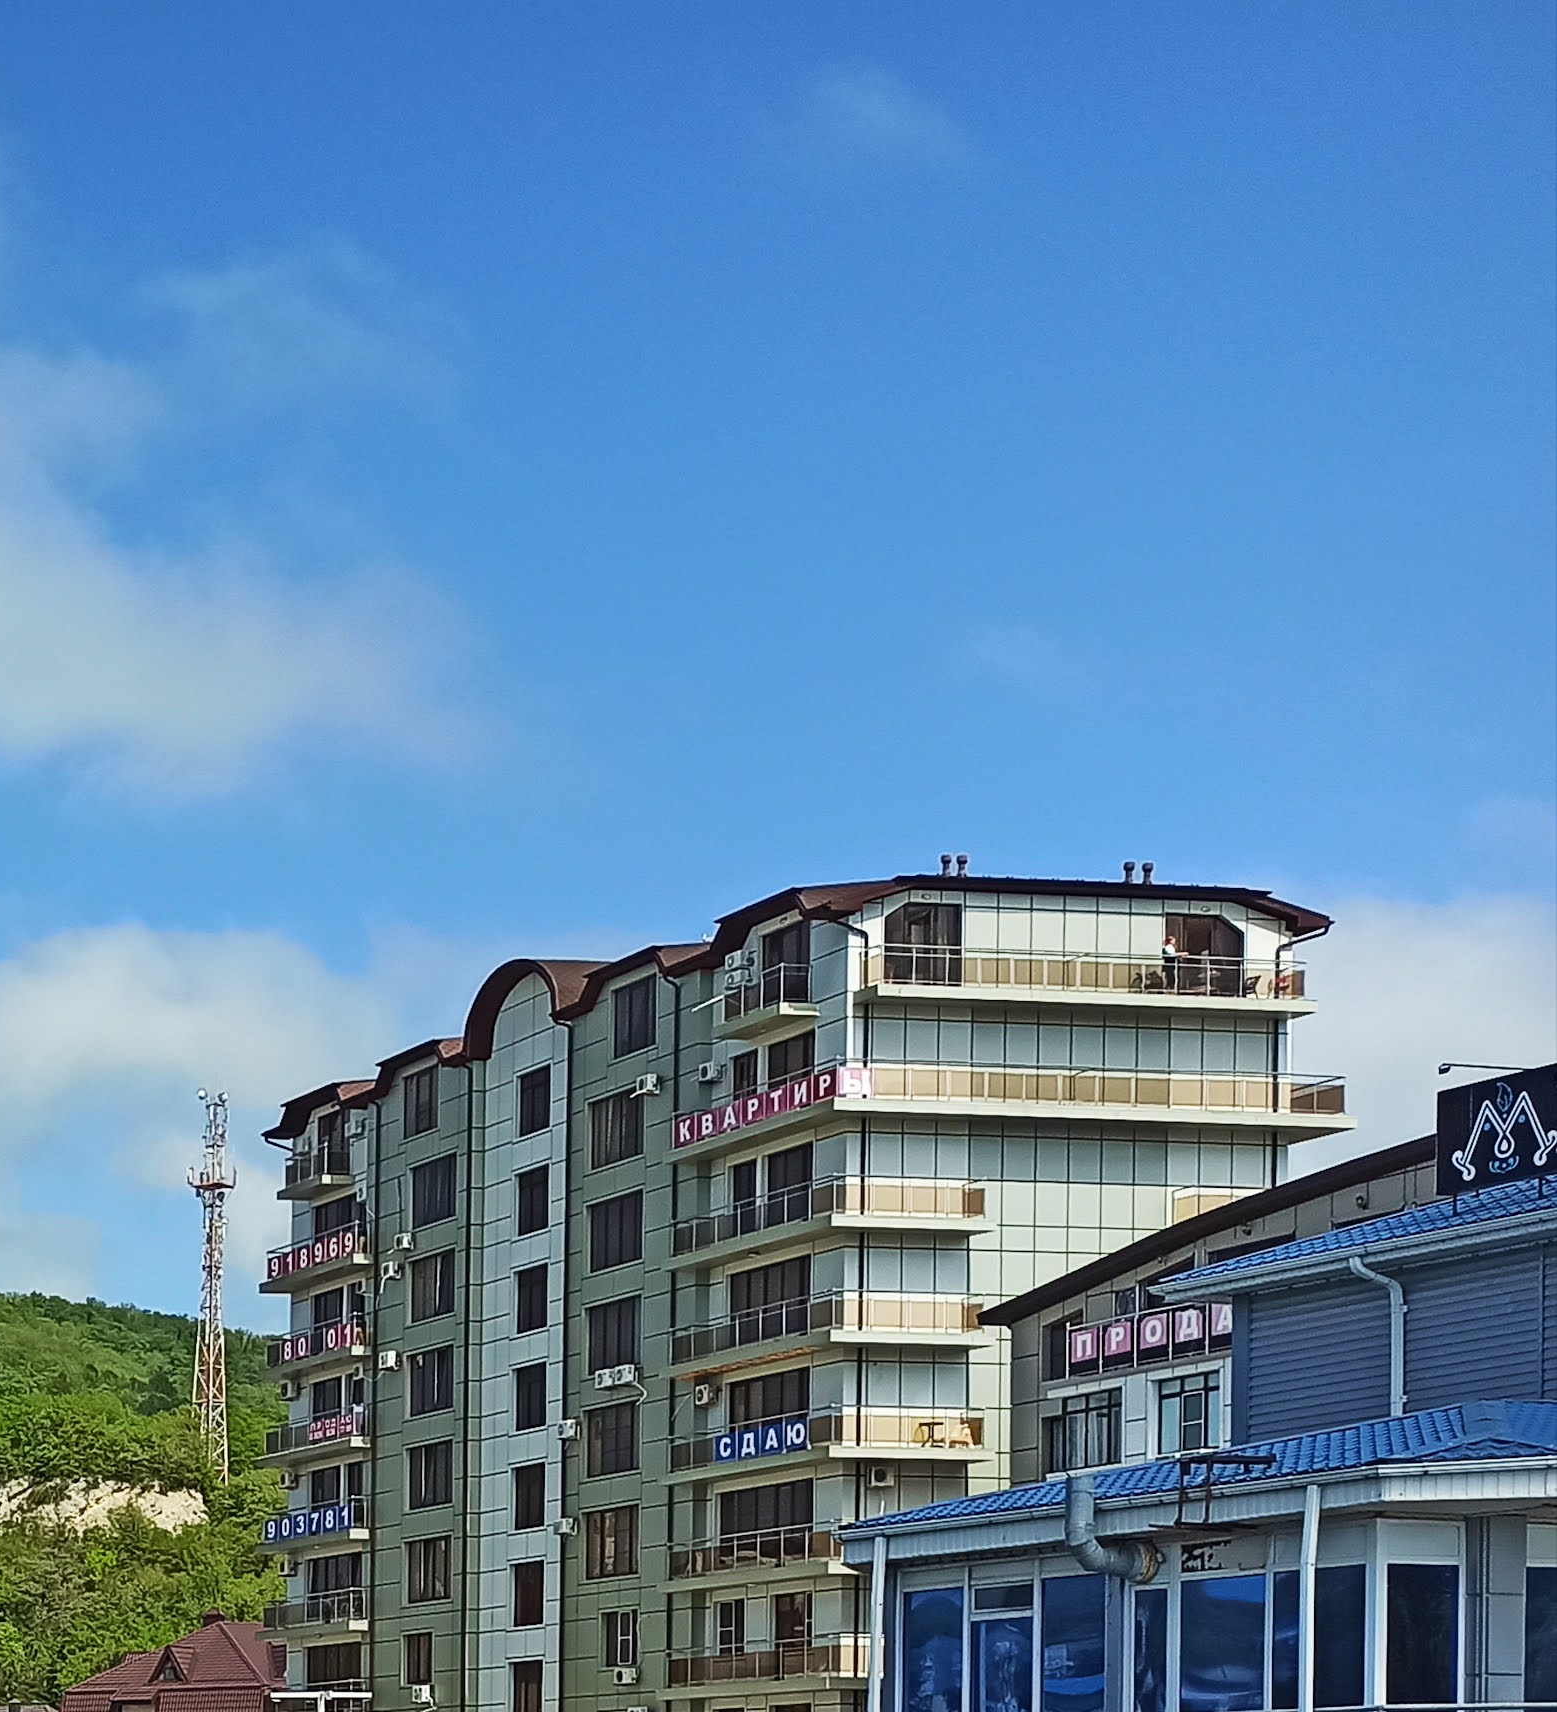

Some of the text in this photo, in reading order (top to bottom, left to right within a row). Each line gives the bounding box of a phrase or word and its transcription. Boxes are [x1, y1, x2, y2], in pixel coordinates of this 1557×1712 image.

[678, 1069, 872, 1143] КВАРТИРЫ
[270, 1232, 354, 1278] 918969
[719, 1422, 806, 1458] СДАЮ
[266, 1505, 349, 1539] 903781
